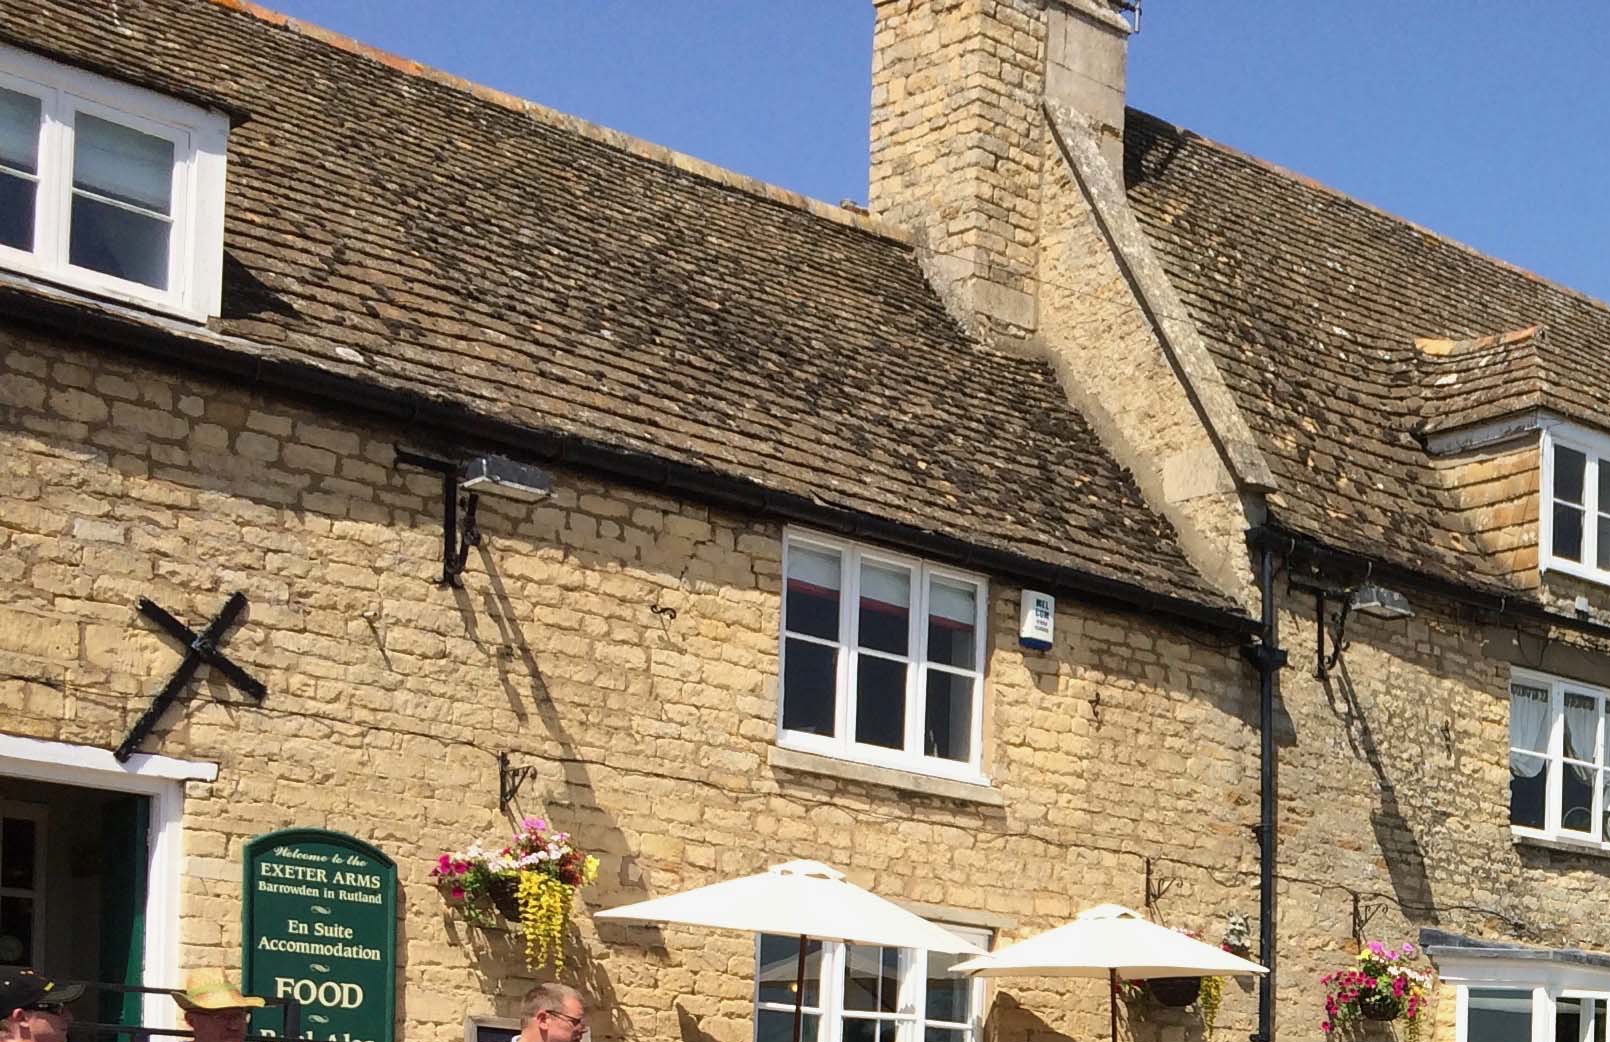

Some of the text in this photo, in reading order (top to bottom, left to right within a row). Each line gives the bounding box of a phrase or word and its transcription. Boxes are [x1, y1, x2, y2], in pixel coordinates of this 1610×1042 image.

[273, 846, 368, 867] Welcome to the
[260, 862, 381, 889] EXETER ARMS
[258, 881, 382, 905] Barrowden in Rutland
[288, 920, 353, 939] En Suite
[258, 936, 381, 960] Accommodation
[274, 976, 364, 1008] FOOD
